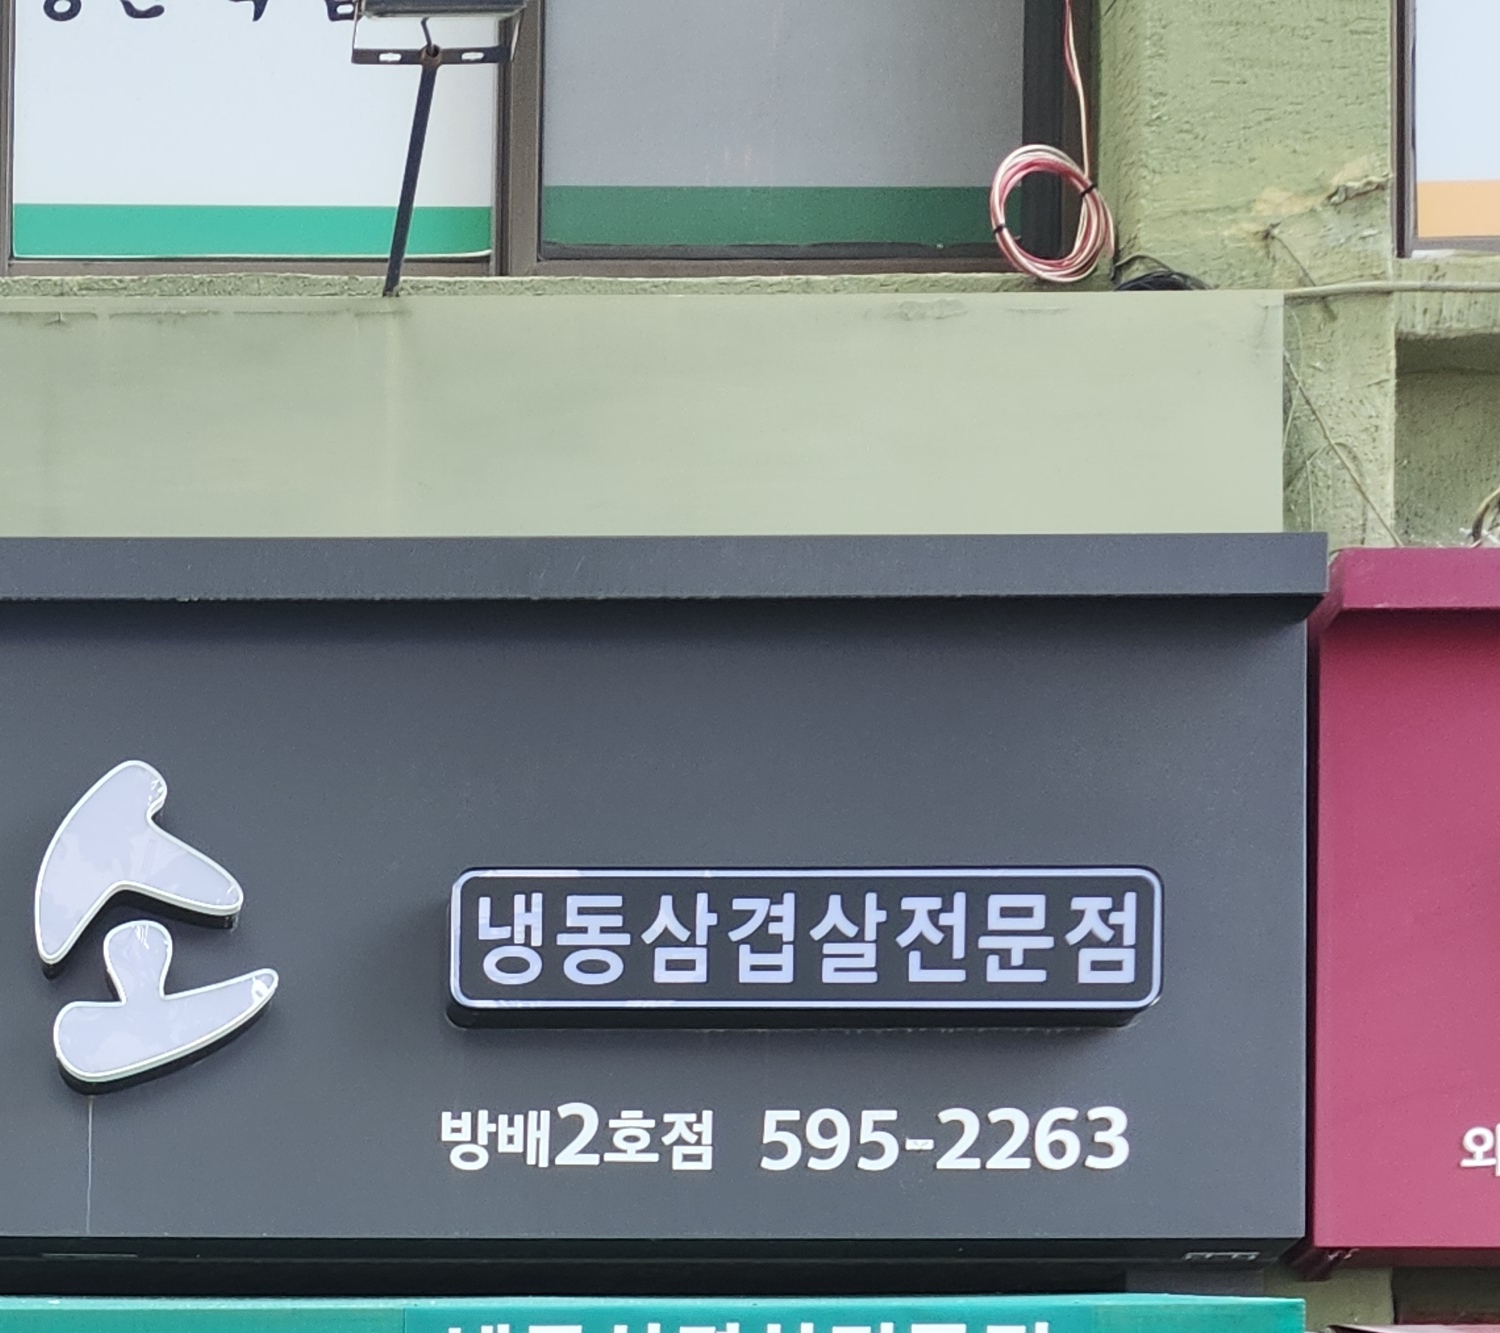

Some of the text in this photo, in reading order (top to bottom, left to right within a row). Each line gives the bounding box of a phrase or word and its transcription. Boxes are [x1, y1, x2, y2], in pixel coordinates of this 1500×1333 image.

[477, 891, 1137, 985] 냉동삼겹살전문점
[440, 1101, 1131, 1171] 방배2호점 595-2263
